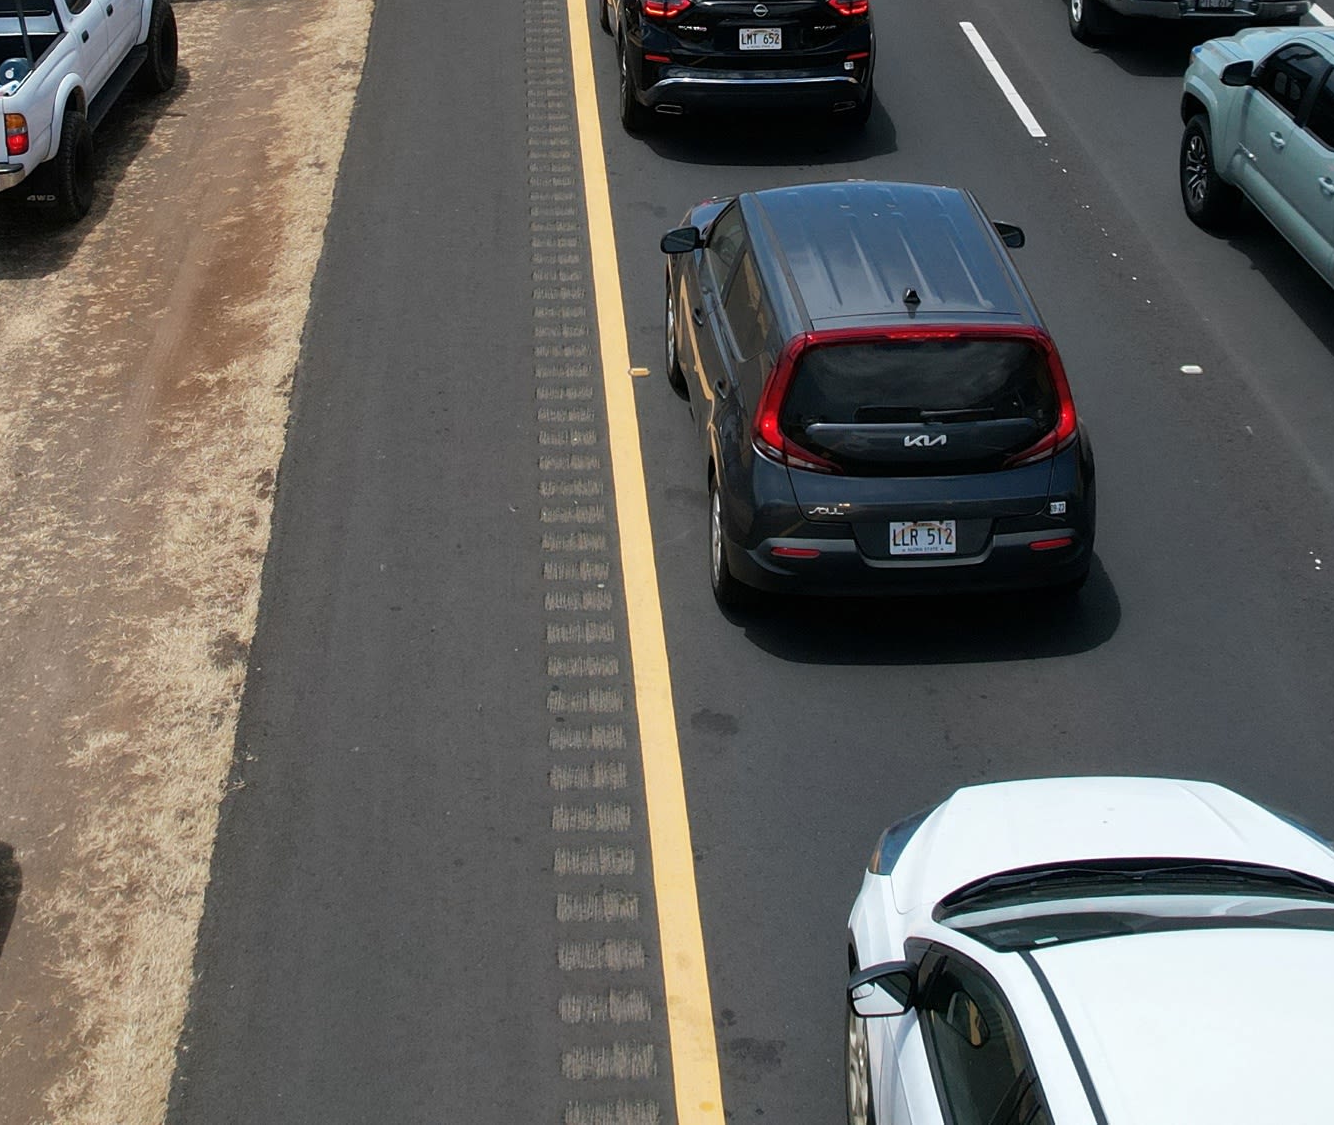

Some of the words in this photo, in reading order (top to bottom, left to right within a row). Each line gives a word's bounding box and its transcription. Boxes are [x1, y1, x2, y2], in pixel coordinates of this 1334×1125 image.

[741, 33, 758, 45] LMT
[762, 33, 780, 45] 652
[27, 194, 56, 202] 4WD
[904, 434, 947, 447] KIA
[808, 506, 845, 516] SOUL
[893, 528, 920, 547] LLR
[927, 527, 953, 546] 512
